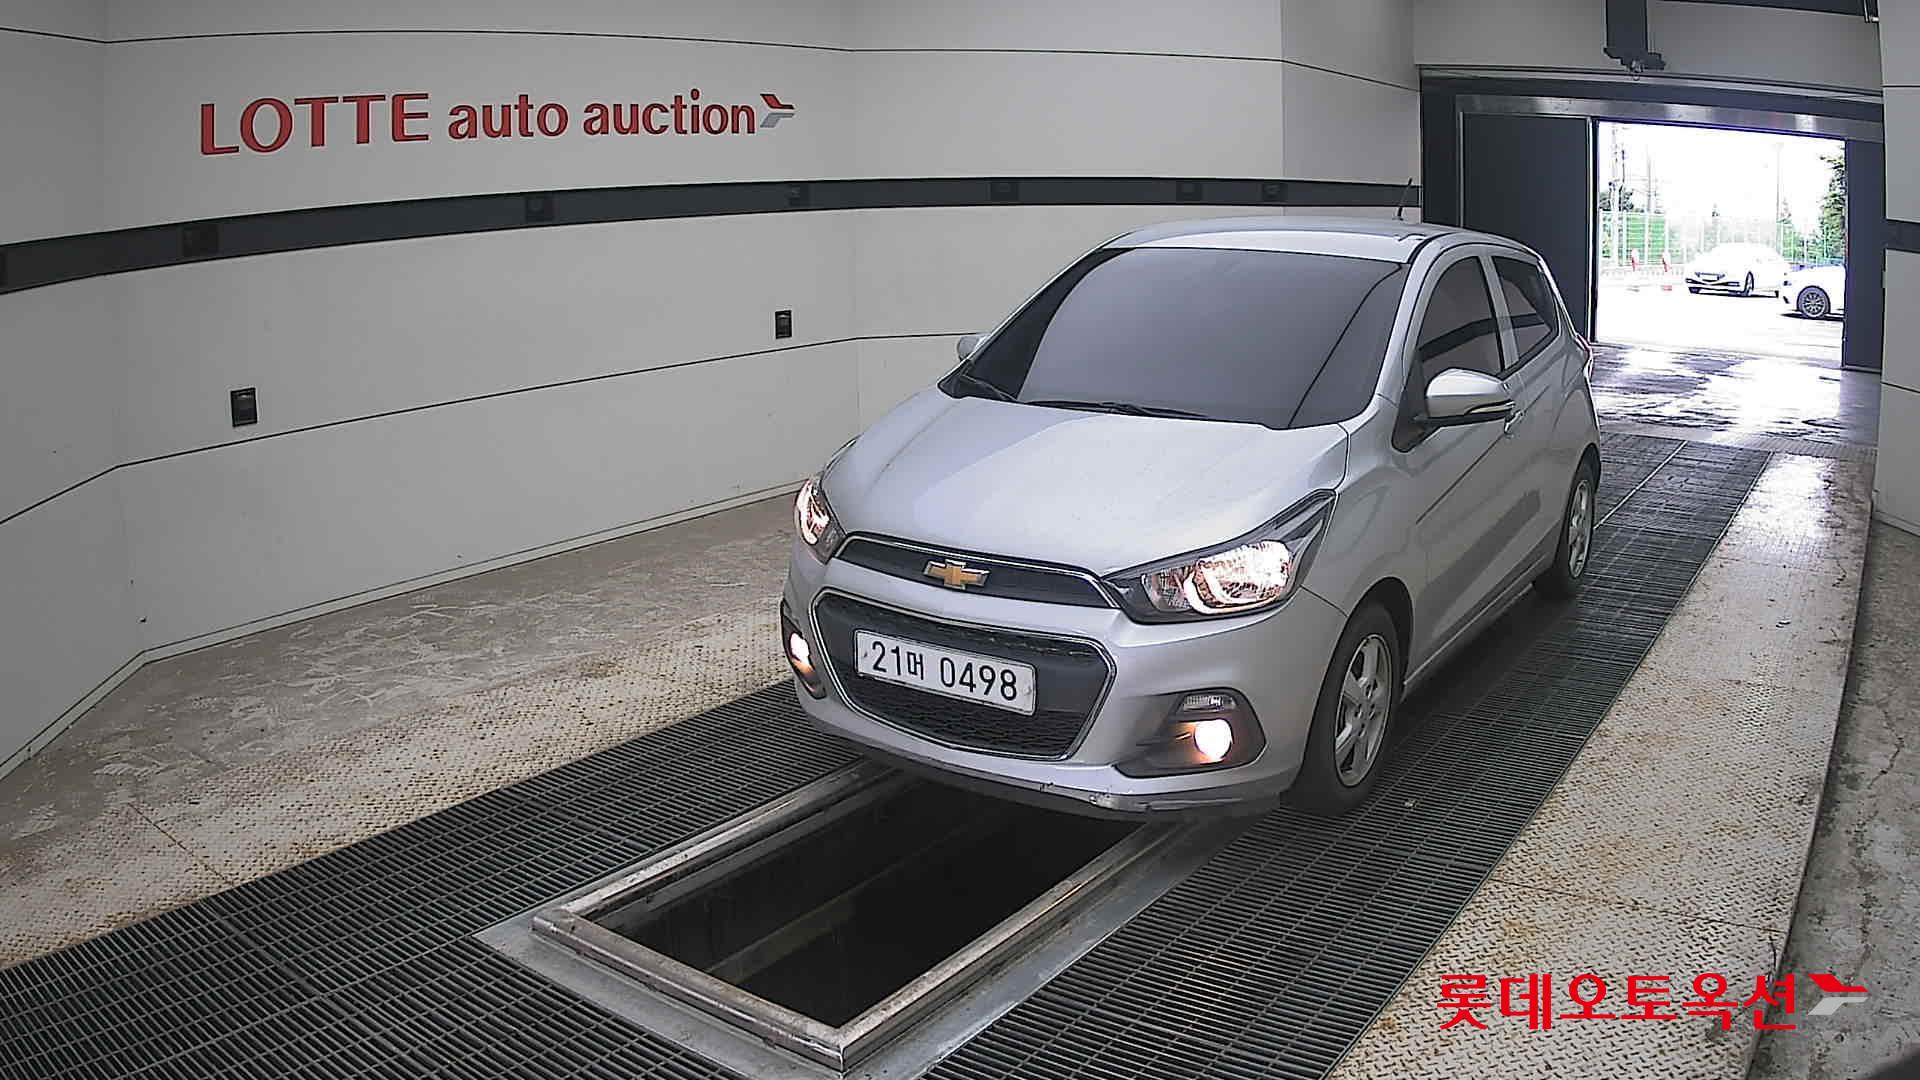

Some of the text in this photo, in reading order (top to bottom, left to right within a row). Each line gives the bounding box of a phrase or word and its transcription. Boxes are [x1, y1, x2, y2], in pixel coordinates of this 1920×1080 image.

[201, 88, 756, 156] LOTTE auto auction
[872, 641, 1017, 701] 21머 0498
